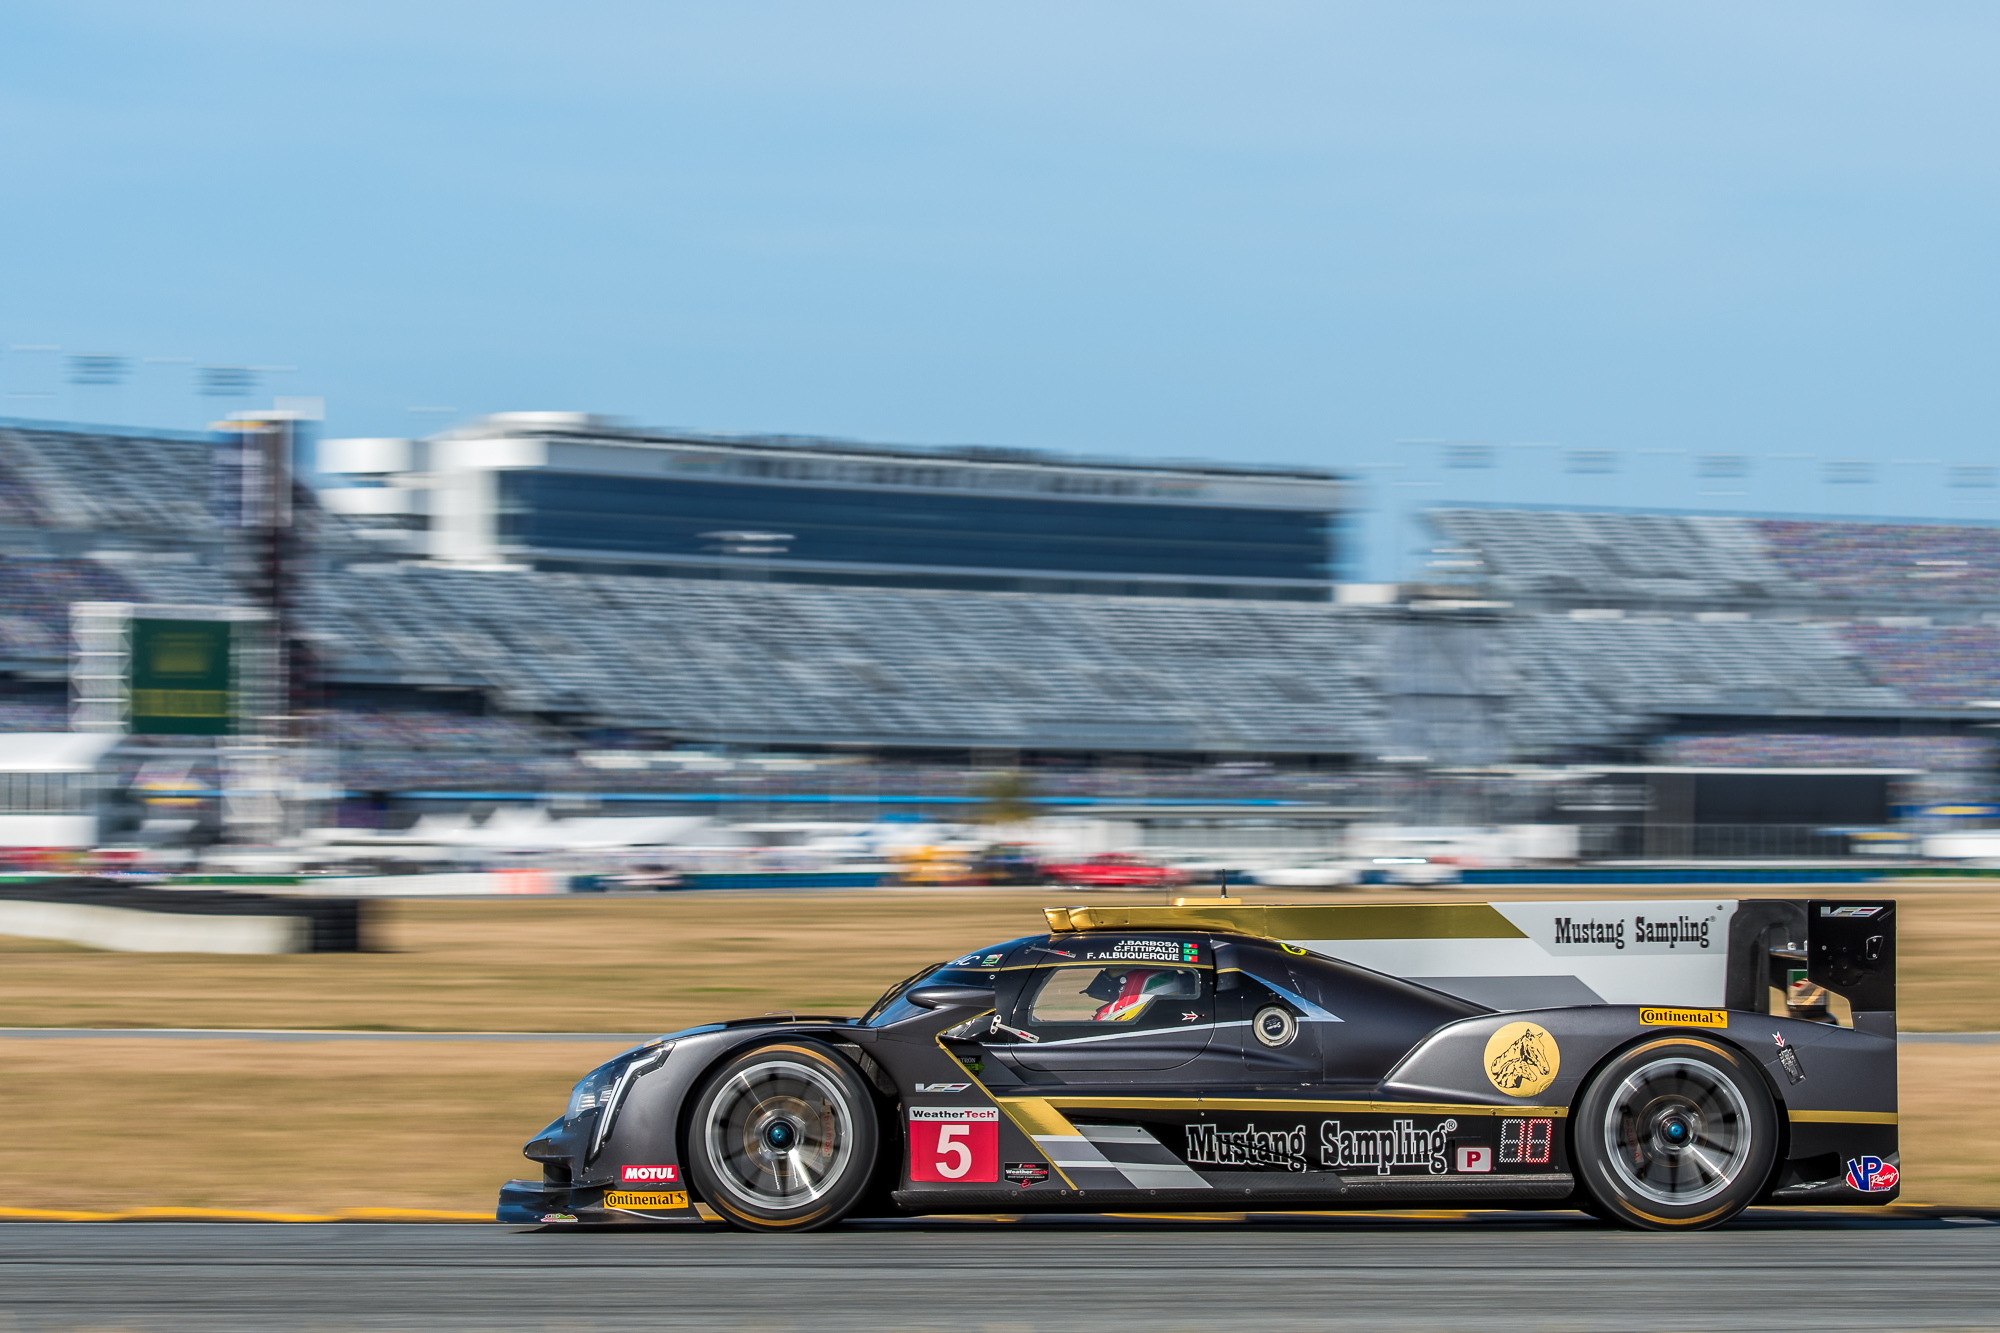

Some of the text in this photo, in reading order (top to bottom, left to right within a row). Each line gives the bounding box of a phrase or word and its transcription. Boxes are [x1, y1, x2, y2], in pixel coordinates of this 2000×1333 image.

[1555, 916, 1709, 949] Mustang Sampling
[1114, 946, 1179, 954] C.FITTIPALDI
[1118, 940, 1180, 948] J.BARBOSA
[1087, 952, 1180, 961] F. ALBUQUERQUE
[1641, 1010, 1713, 1024] Continental
[913, 1110, 995, 1118] WeatherTech
[936, 1125, 972, 1179] 5
[1186, 1123, 1306, 1173] Mustang
[1467, 1151, 1481, 1168] P
[625, 1168, 675, 1179] MOTUL
[1847, 1156, 1883, 1191] VP
[1871, 1172, 1898, 1186] Racing
[606, 1193, 674, 1207] Continental
